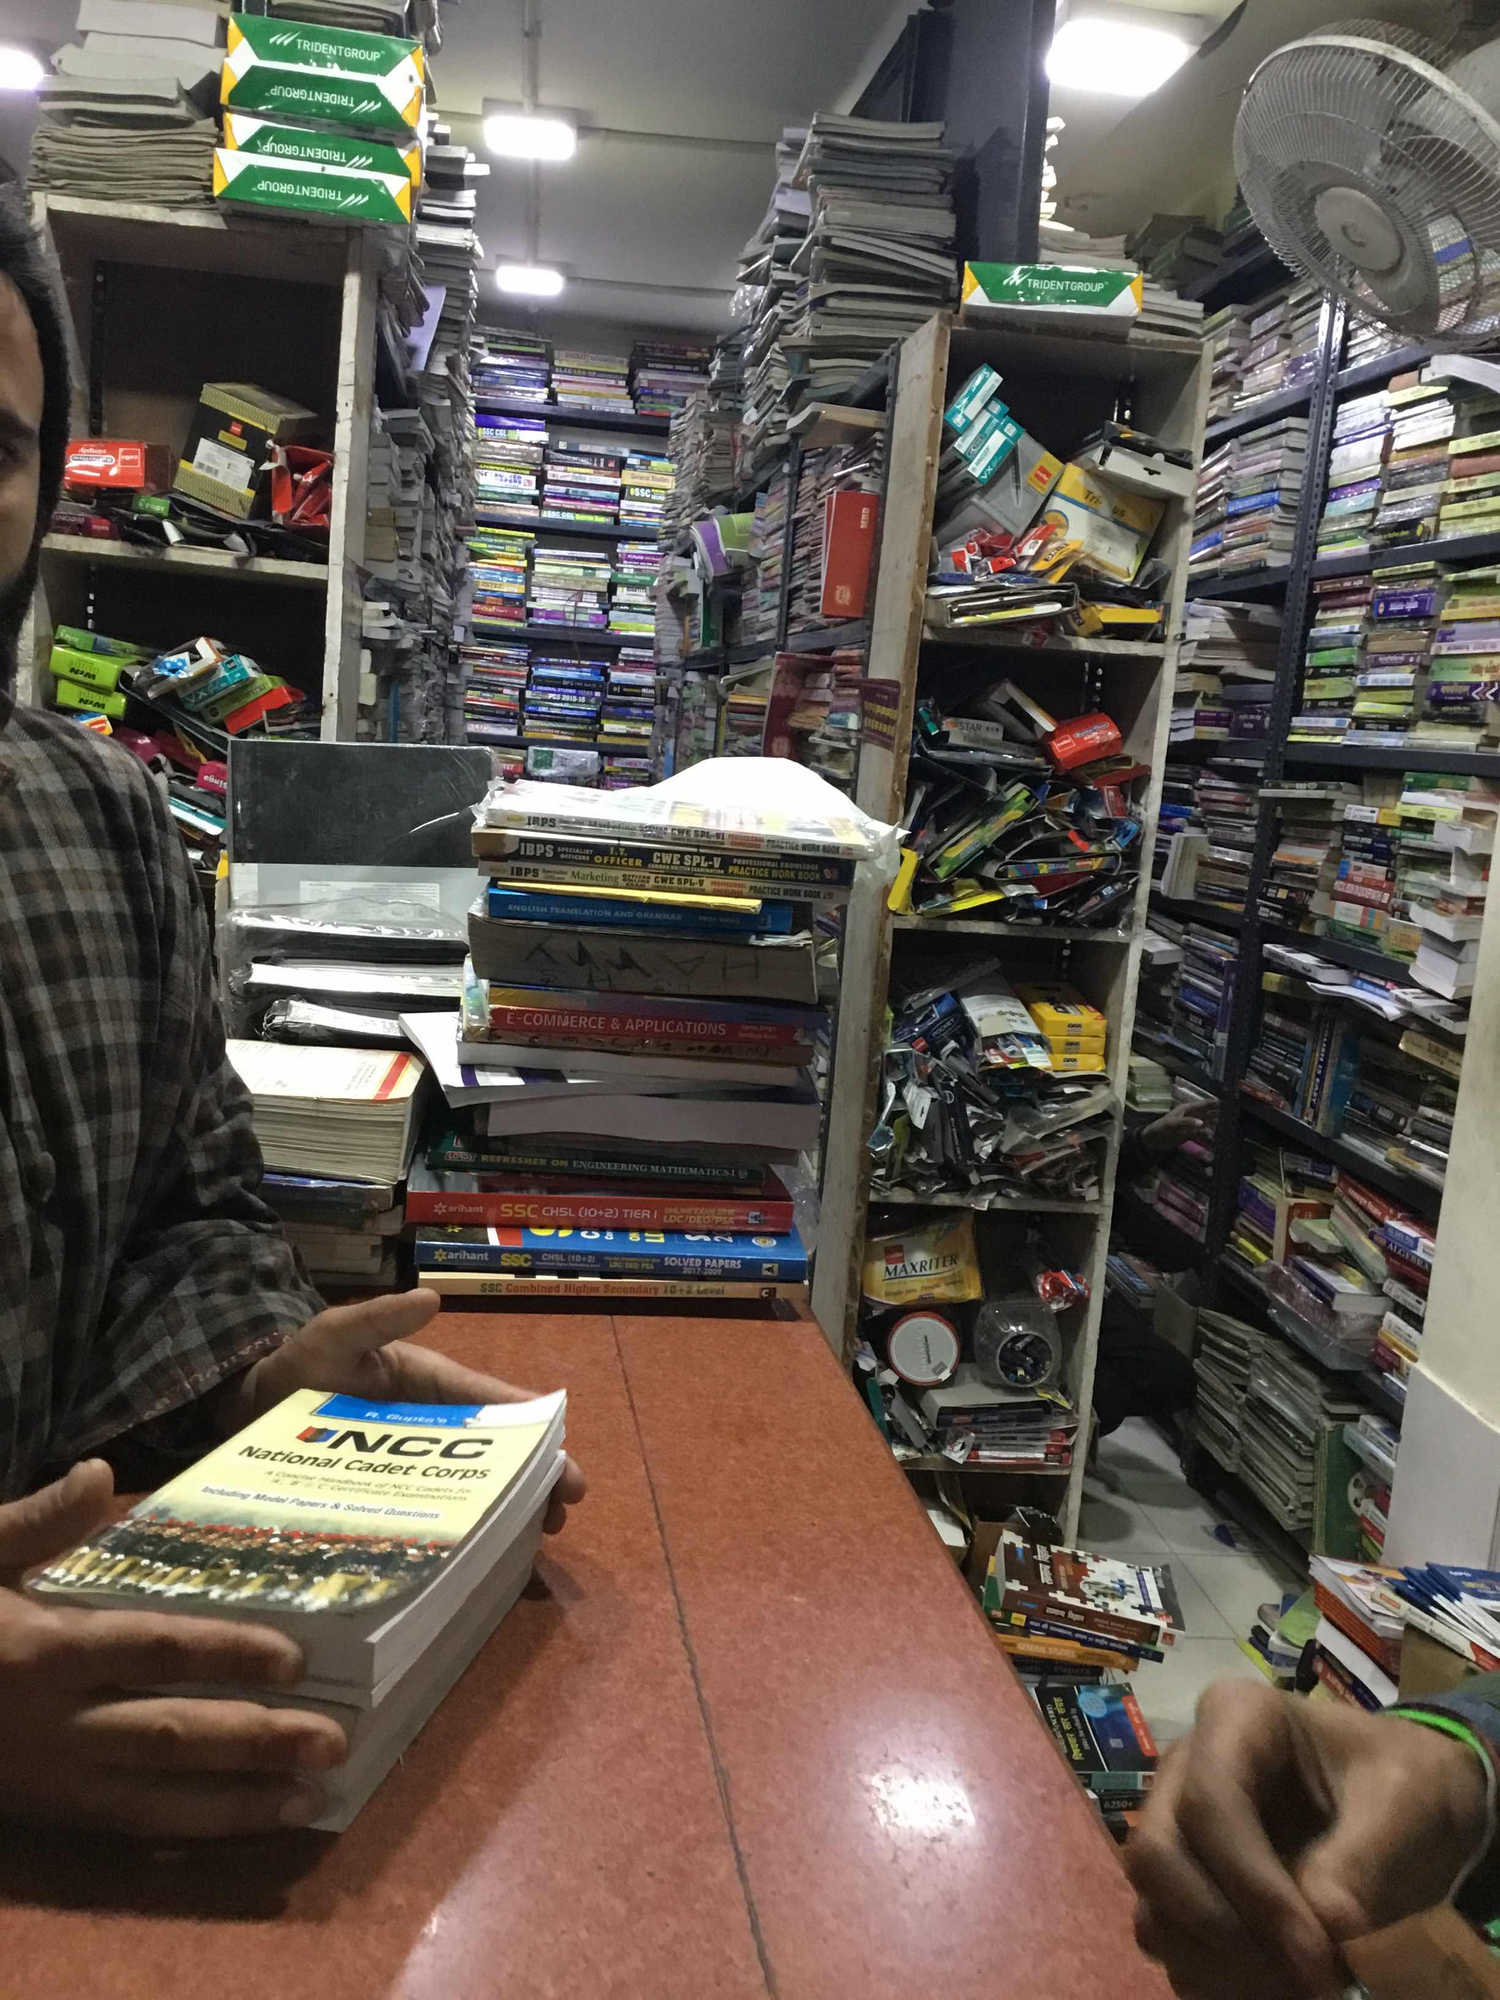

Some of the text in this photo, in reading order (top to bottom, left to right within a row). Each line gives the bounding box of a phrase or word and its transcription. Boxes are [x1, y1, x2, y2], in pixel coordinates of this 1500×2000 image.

[297, 38, 382, 62] TRIDENTGROUP
[269, 85, 355, 107] TRIDENTGROUP
[261, 141, 347, 163] TRIDENTGROUP
[255, 179, 343, 201] TRIDENTGROUP
[1026, 277, 1105, 293] TRIDENTGROUP
[527, 815, 557, 829] IBPS
[518, 842, 555, 858] IBPS
[593, 855, 644, 868] OFFICER
[652, 852, 722, 869] CWE SPL-V
[510, 865, 540, 879] IBPS
[570, 868, 621, 884] Marketing
[654, 876, 677, 886] CWE
[748, 884, 783, 898] PRACTICE
[783, 887, 803, 898] WORK
[728, 866, 822, 882] PRACTICE WORK BOOK
[507, 903, 548, 914] ENGLISH
[612, 910, 634, 919] AND
[506, 1012, 606, 1031] E-COMMERCE
[610, 1017, 621, 1031] &
[624, 1017, 727, 1037] APPLICATIONS
[480, 1154, 548, 1166] REFRESHER
[551, 1159, 569, 1168] ON
[572, 1161, 648, 1173] ENGINEERING
[500, 1203, 539, 1218] SSC
[542, 1206, 576, 1218] CHSL
[578, 1206, 619, 1219] (10+2)
[622, 1208, 651, 1219] TIER
[447, 1249, 490, 1261] arihant
[500, 1252, 534, 1267] SSC
[540, 1252, 565, 1263] CHSL
[663, 1256, 703, 1268] SOLVED
[704, 1257, 742, 1270] PAPERS
[884, 1255, 959, 1277] MAXRITER
[479, 1282, 504, 1294] SSC
[505, 1283, 561, 1295] Combined
[564, 1283, 601, 1296] Higher
[602, 1282, 660, 1296] Secondary
[696, 1285, 726, 1296] Level
[385, 1412, 449, 1424] Gupta's
[326, 1430, 495, 1460] NCC
[237, 1445, 492, 1481] National Cadet Corps
[201, 1486, 252, 1501] Including
[252, 1492, 289, 1505] Model
[287, 1497, 329, 1511] Papers
[342, 1503, 384, 1516] Solved
[383, 1506, 442, 1521] Questions
